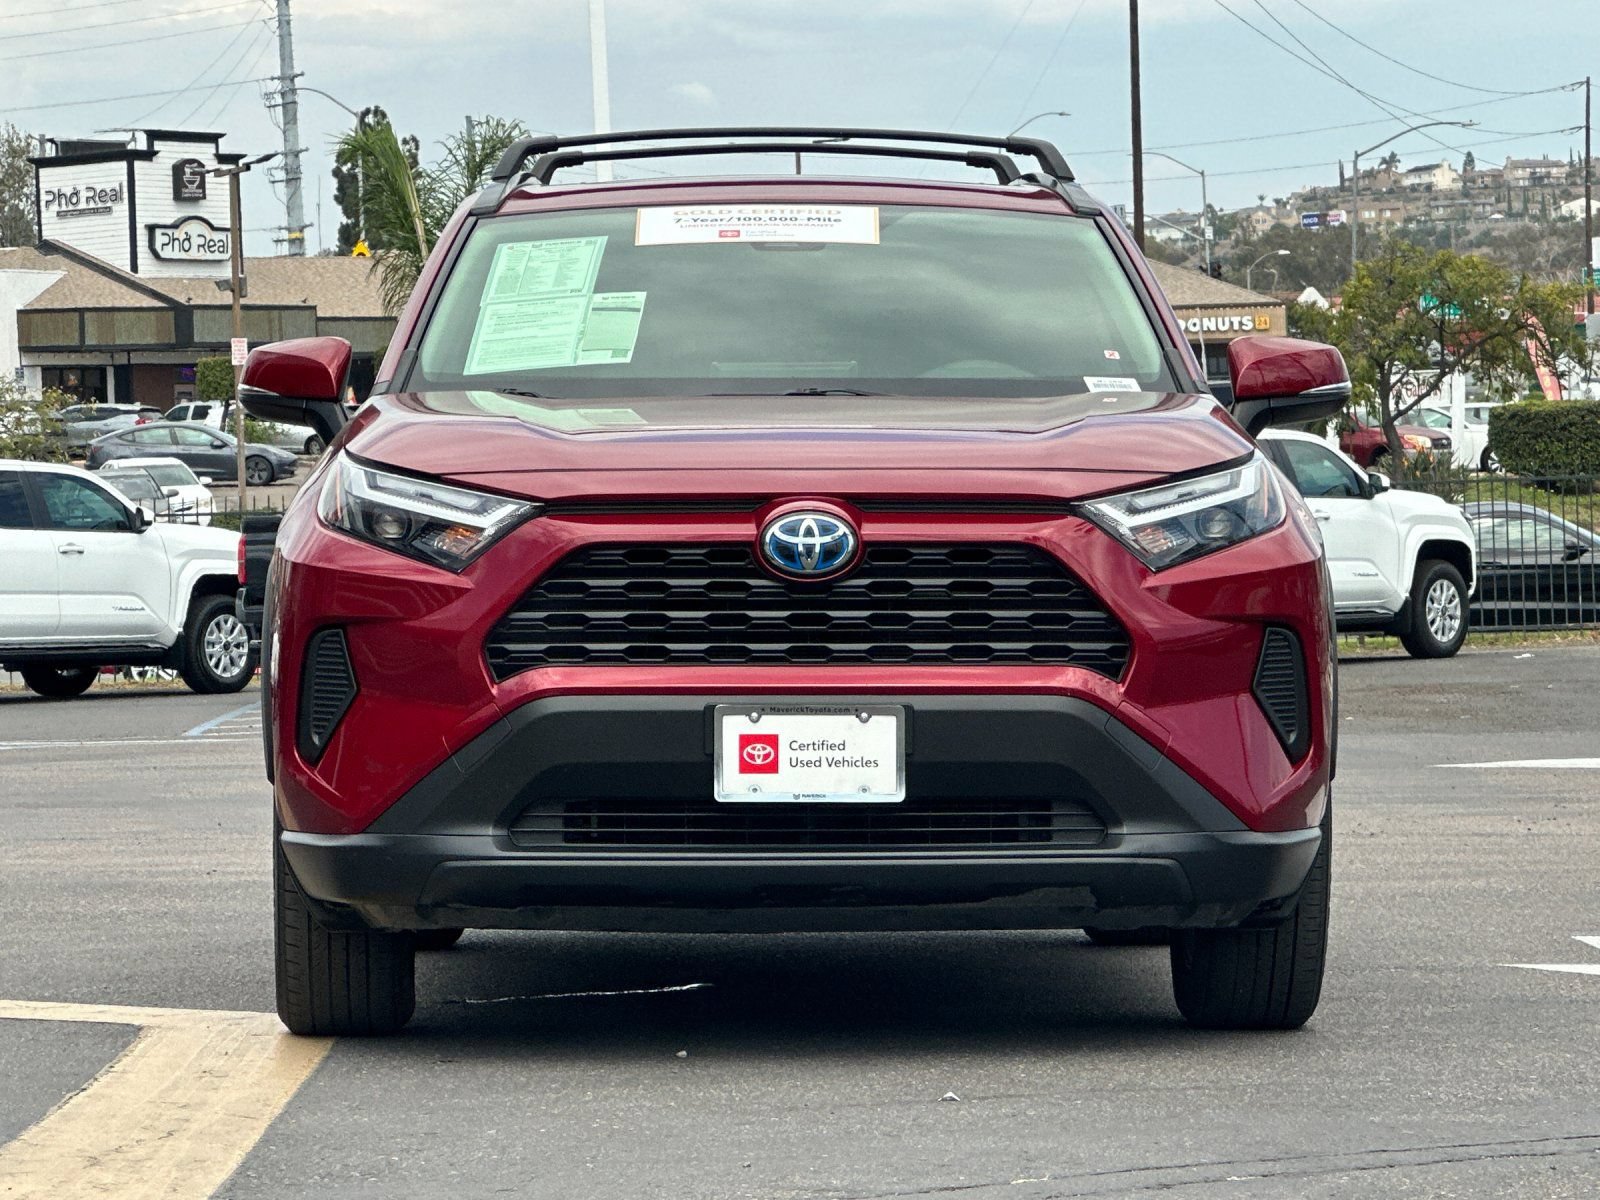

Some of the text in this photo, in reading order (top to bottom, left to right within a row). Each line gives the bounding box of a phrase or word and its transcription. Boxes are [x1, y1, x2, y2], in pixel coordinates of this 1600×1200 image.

[86, 182, 124, 204] Real
[197, 232, 229, 254] Real
[769, 706, 850, 714] MaverickToyota.com
[789, 740, 846, 751] Certified
[789, 757, 879, 768] Used Vehicles
